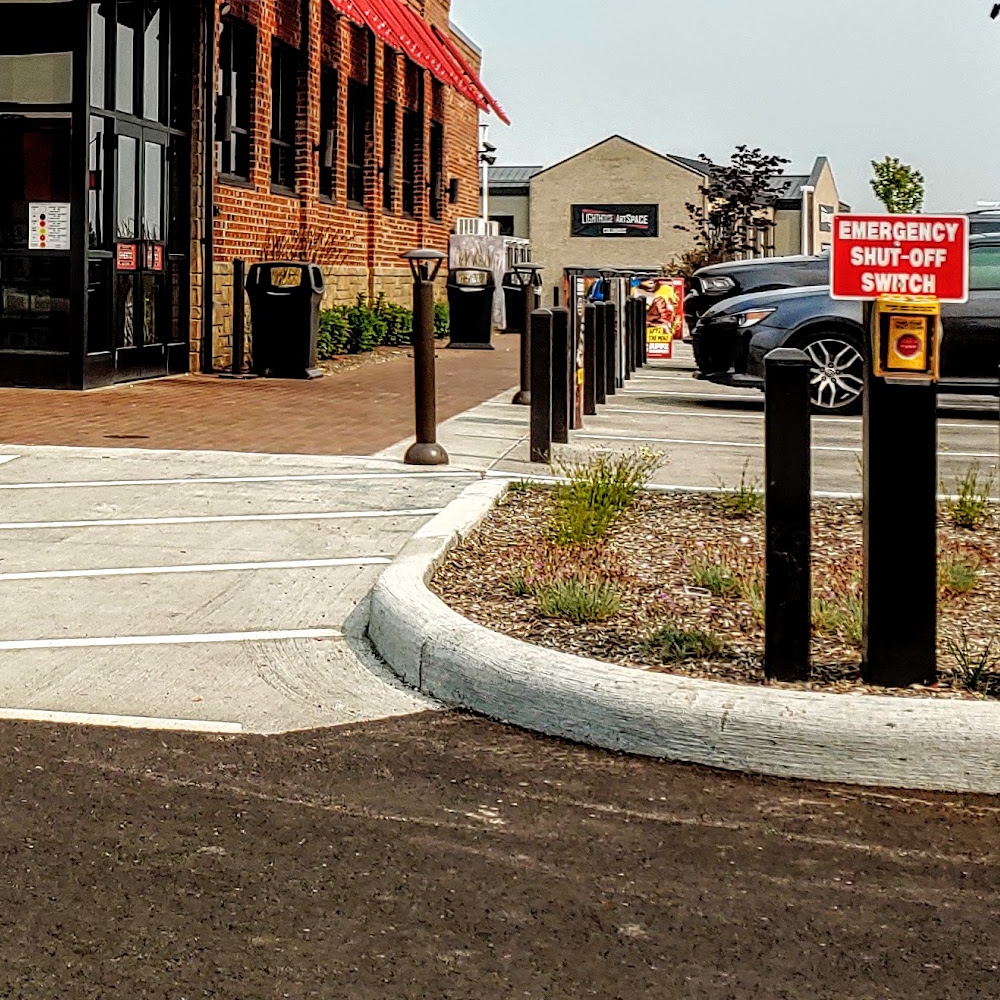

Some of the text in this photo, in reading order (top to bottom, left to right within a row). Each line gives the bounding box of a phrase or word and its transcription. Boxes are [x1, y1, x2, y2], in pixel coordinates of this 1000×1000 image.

[838, 220, 960, 243] EMERGENCY
[850, 246, 948, 268] SHUT-OFF
[860, 272, 937, 294] SWITCH
